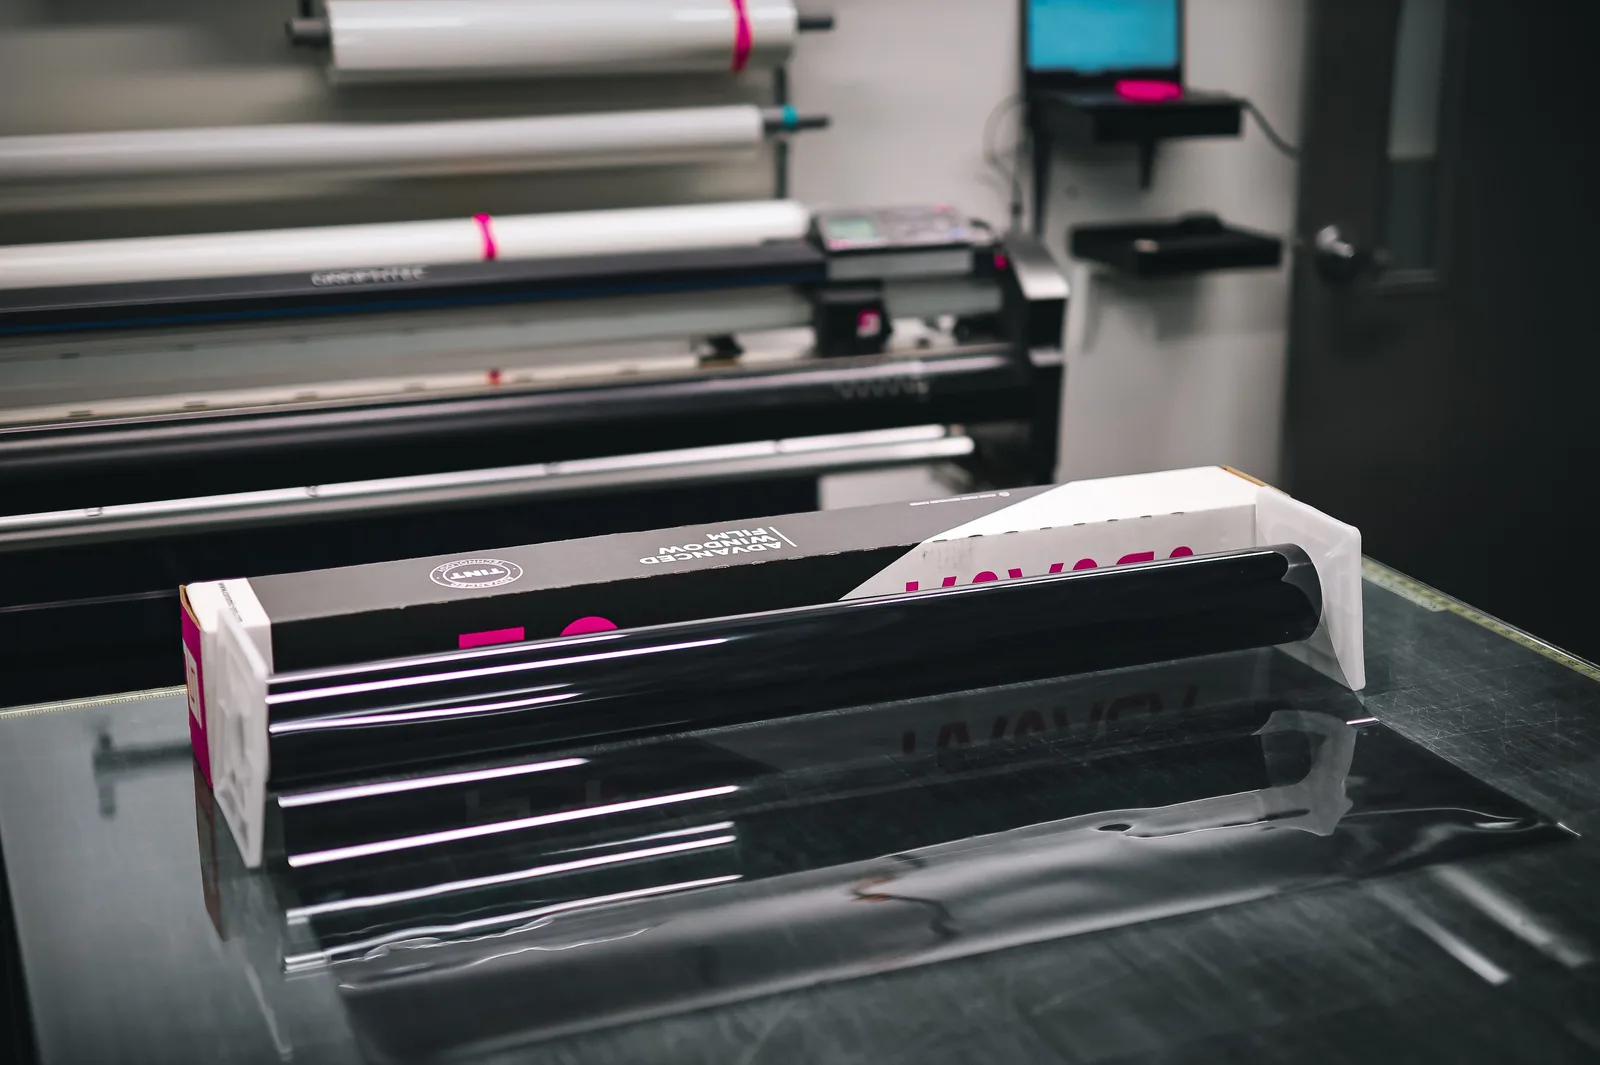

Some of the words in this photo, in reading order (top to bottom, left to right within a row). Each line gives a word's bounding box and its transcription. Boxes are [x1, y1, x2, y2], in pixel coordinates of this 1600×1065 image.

[706, 527, 768, 541] FILM
[639, 541, 782, 565] ADVANCED
[659, 535, 778, 555] WINDOW
[450, 567, 505, 580] TINT
